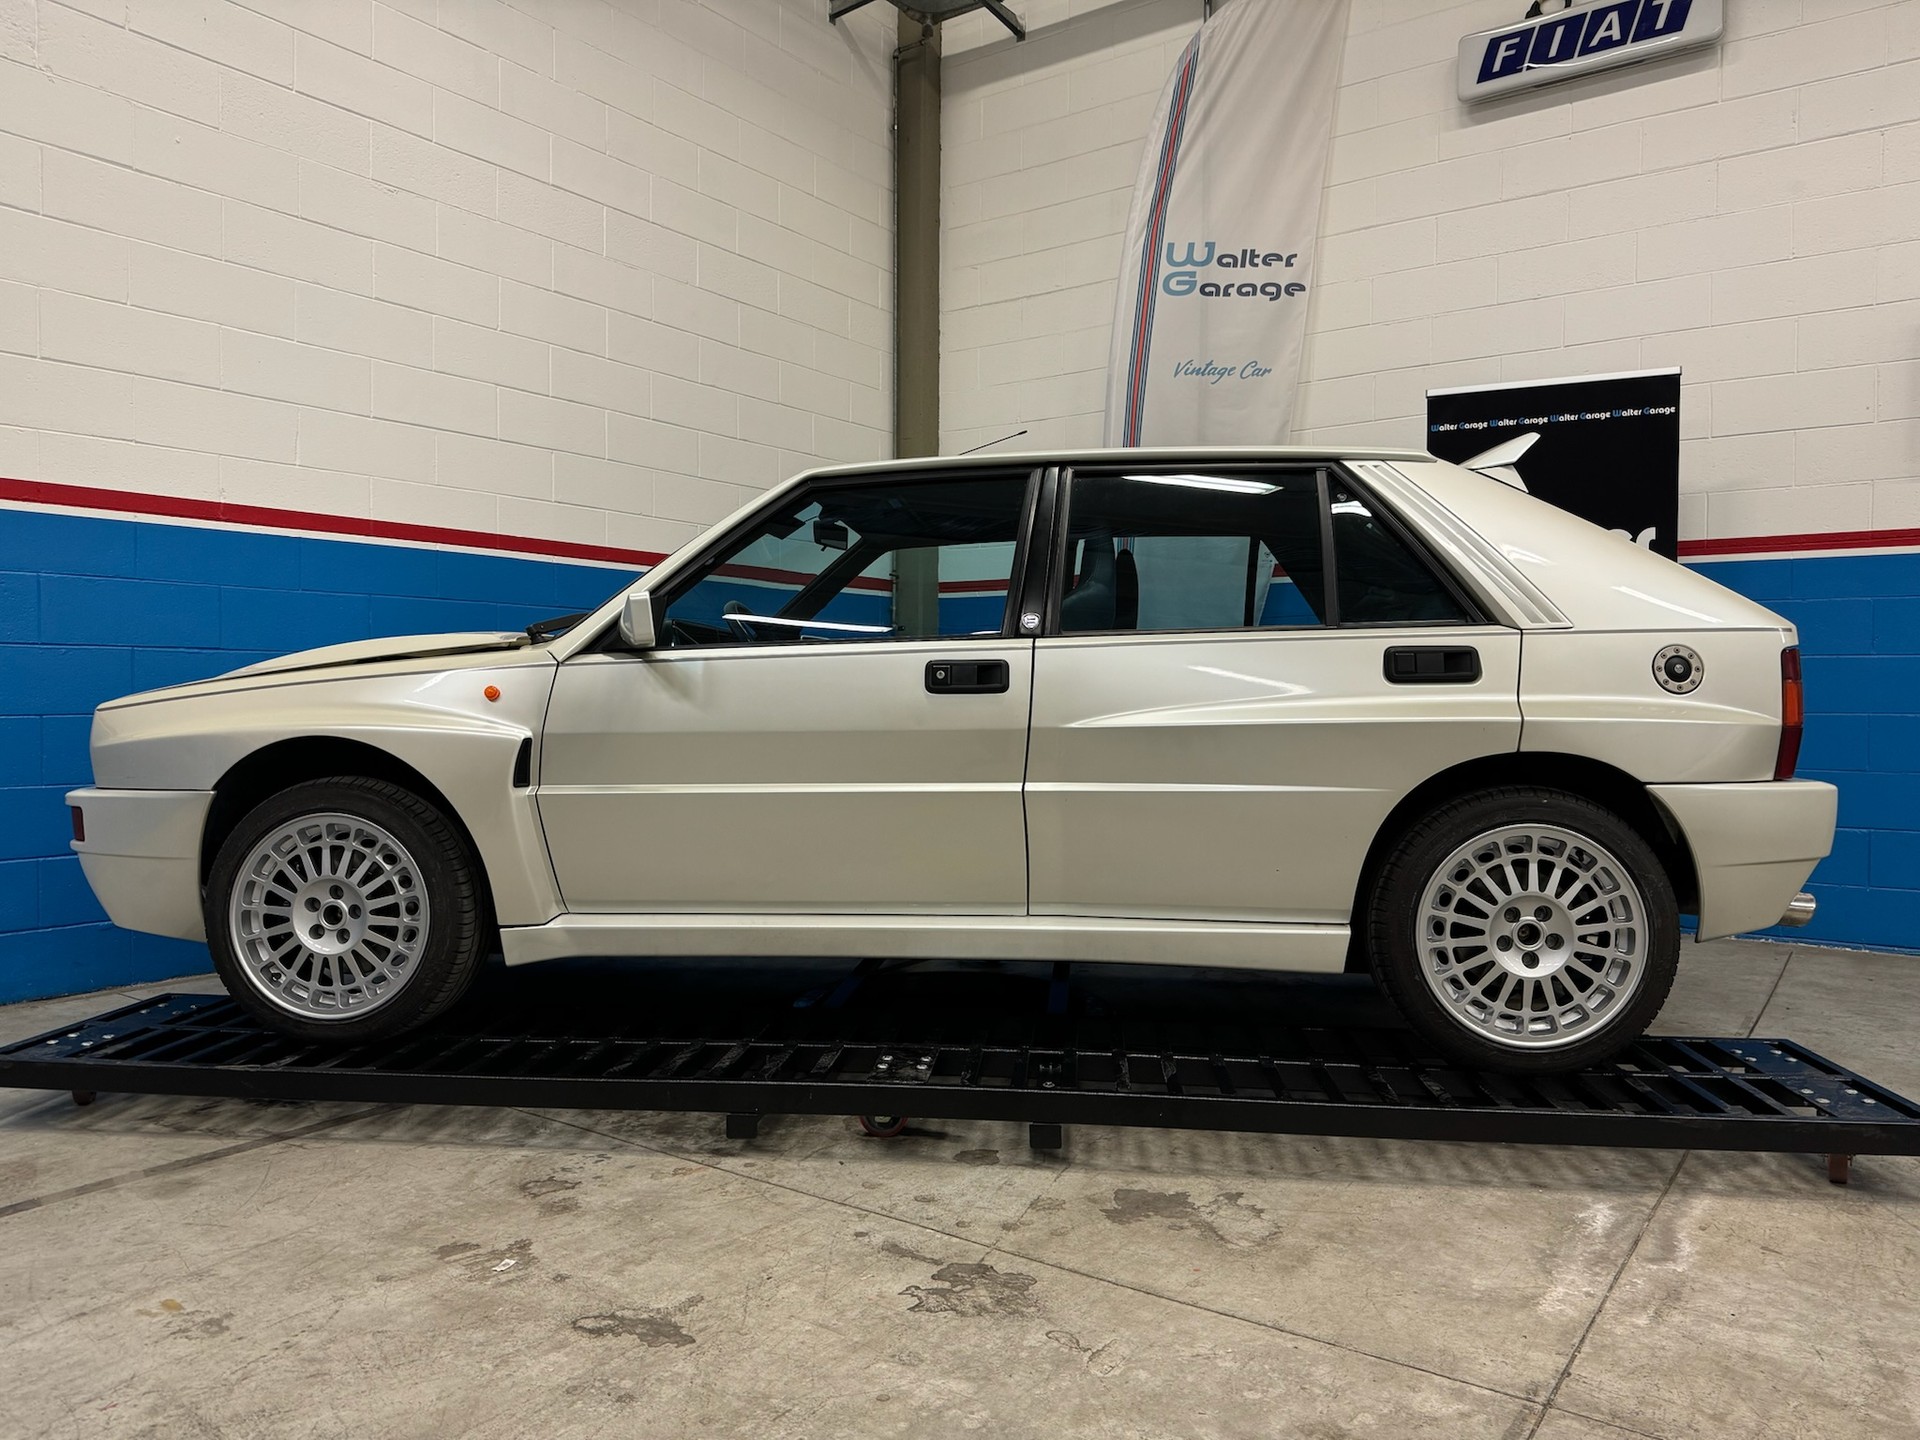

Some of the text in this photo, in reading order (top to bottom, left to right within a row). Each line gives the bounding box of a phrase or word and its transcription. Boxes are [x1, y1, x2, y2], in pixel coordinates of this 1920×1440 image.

[1491, 0, 1673, 73] FIAT
[1165, 241, 1298, 268] Walter
[1162, 270, 1307, 302] Garage
[1173, 359, 1273, 385] Vintage Car
[1430, 406, 1676, 432] Walter Garage Walter Garage Walter Garage Walter Garage
